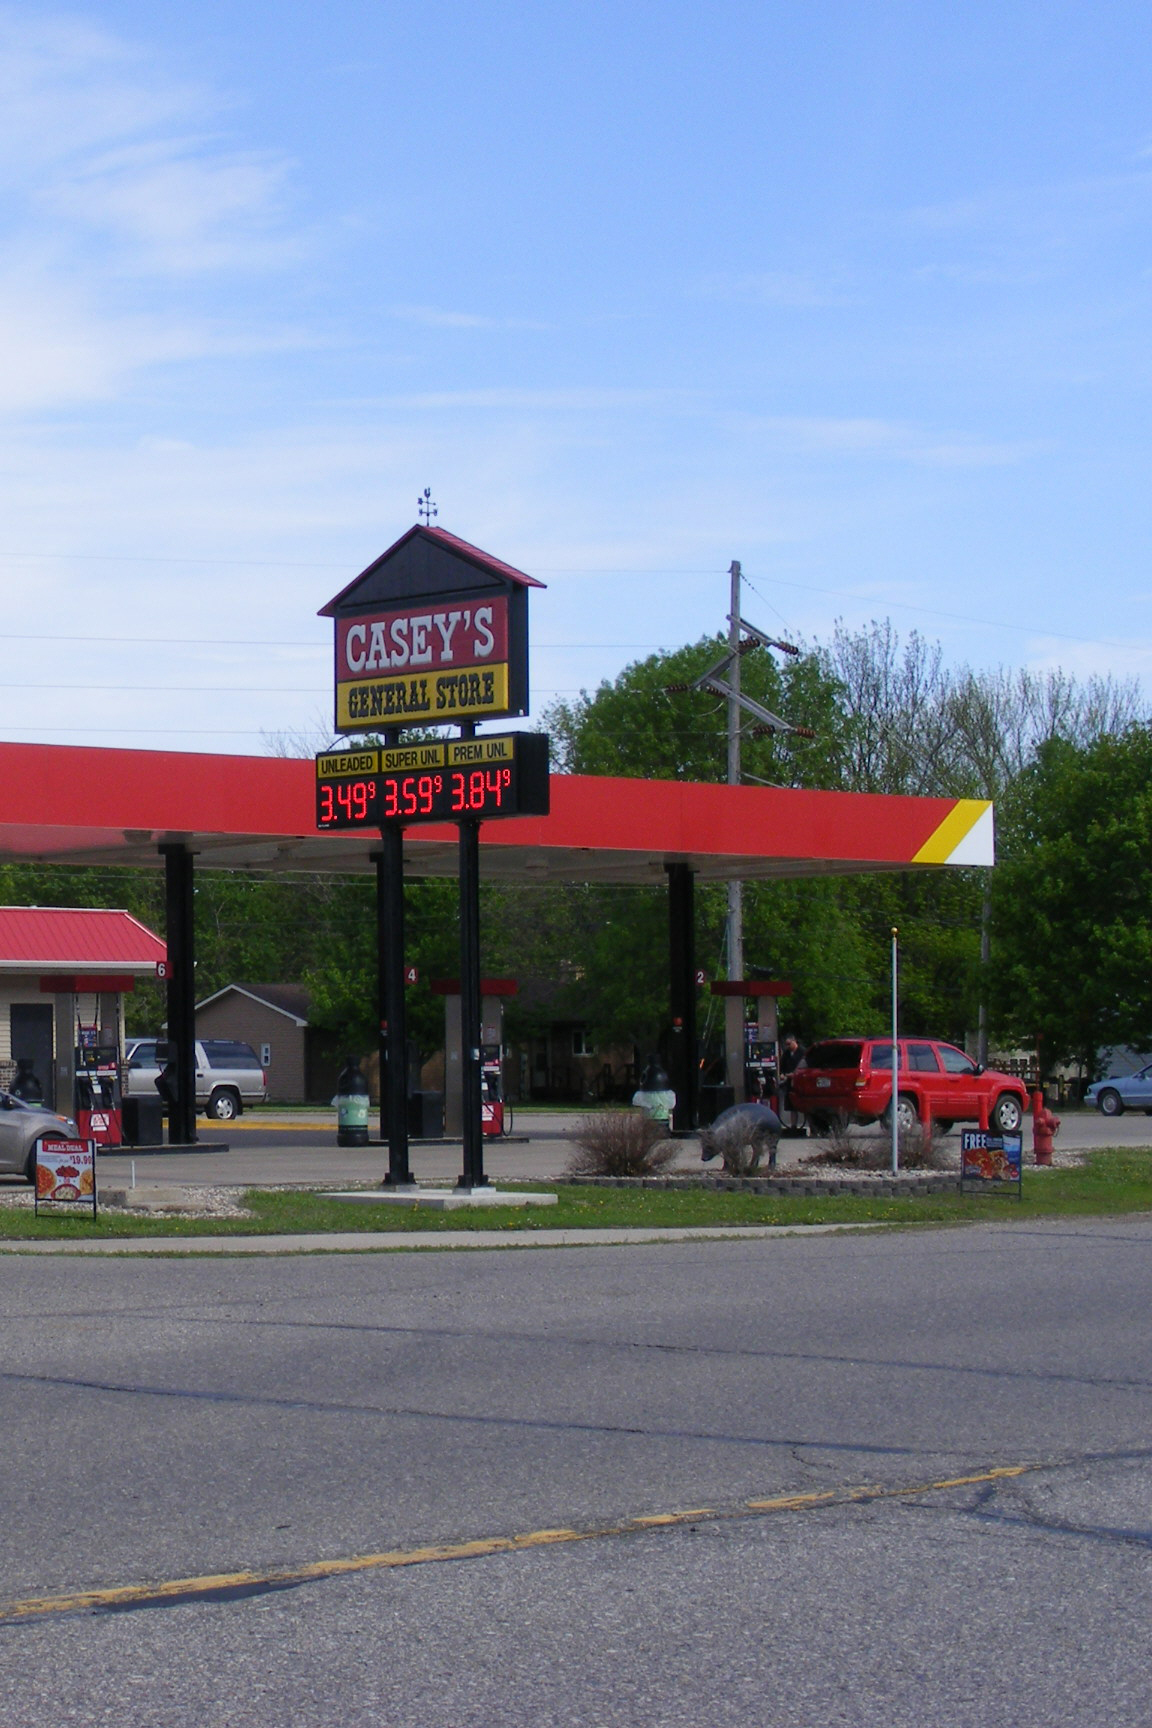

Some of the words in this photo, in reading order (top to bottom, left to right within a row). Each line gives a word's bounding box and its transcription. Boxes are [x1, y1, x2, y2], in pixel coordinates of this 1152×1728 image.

[346, 606, 495, 673] CASEY'S
[348, 678, 430, 719] GENERAL
[436, 671, 494, 710] STORE
[385, 751, 418, 769] SUPER
[420, 748, 441, 765] UNL
[453, 744, 483, 762] PREM
[486, 742, 508, 758] UNL
[321, 755, 373, 775] UNLEADED
[158, 962, 166, 977] 6
[408, 968, 417, 981] 4
[697, 971, 704, 983] 2
[47, 1144, 65, 1152] MEAL
[66, 1144, 83, 1152] DEAL
[964, 1133, 987, 1150] FREE
